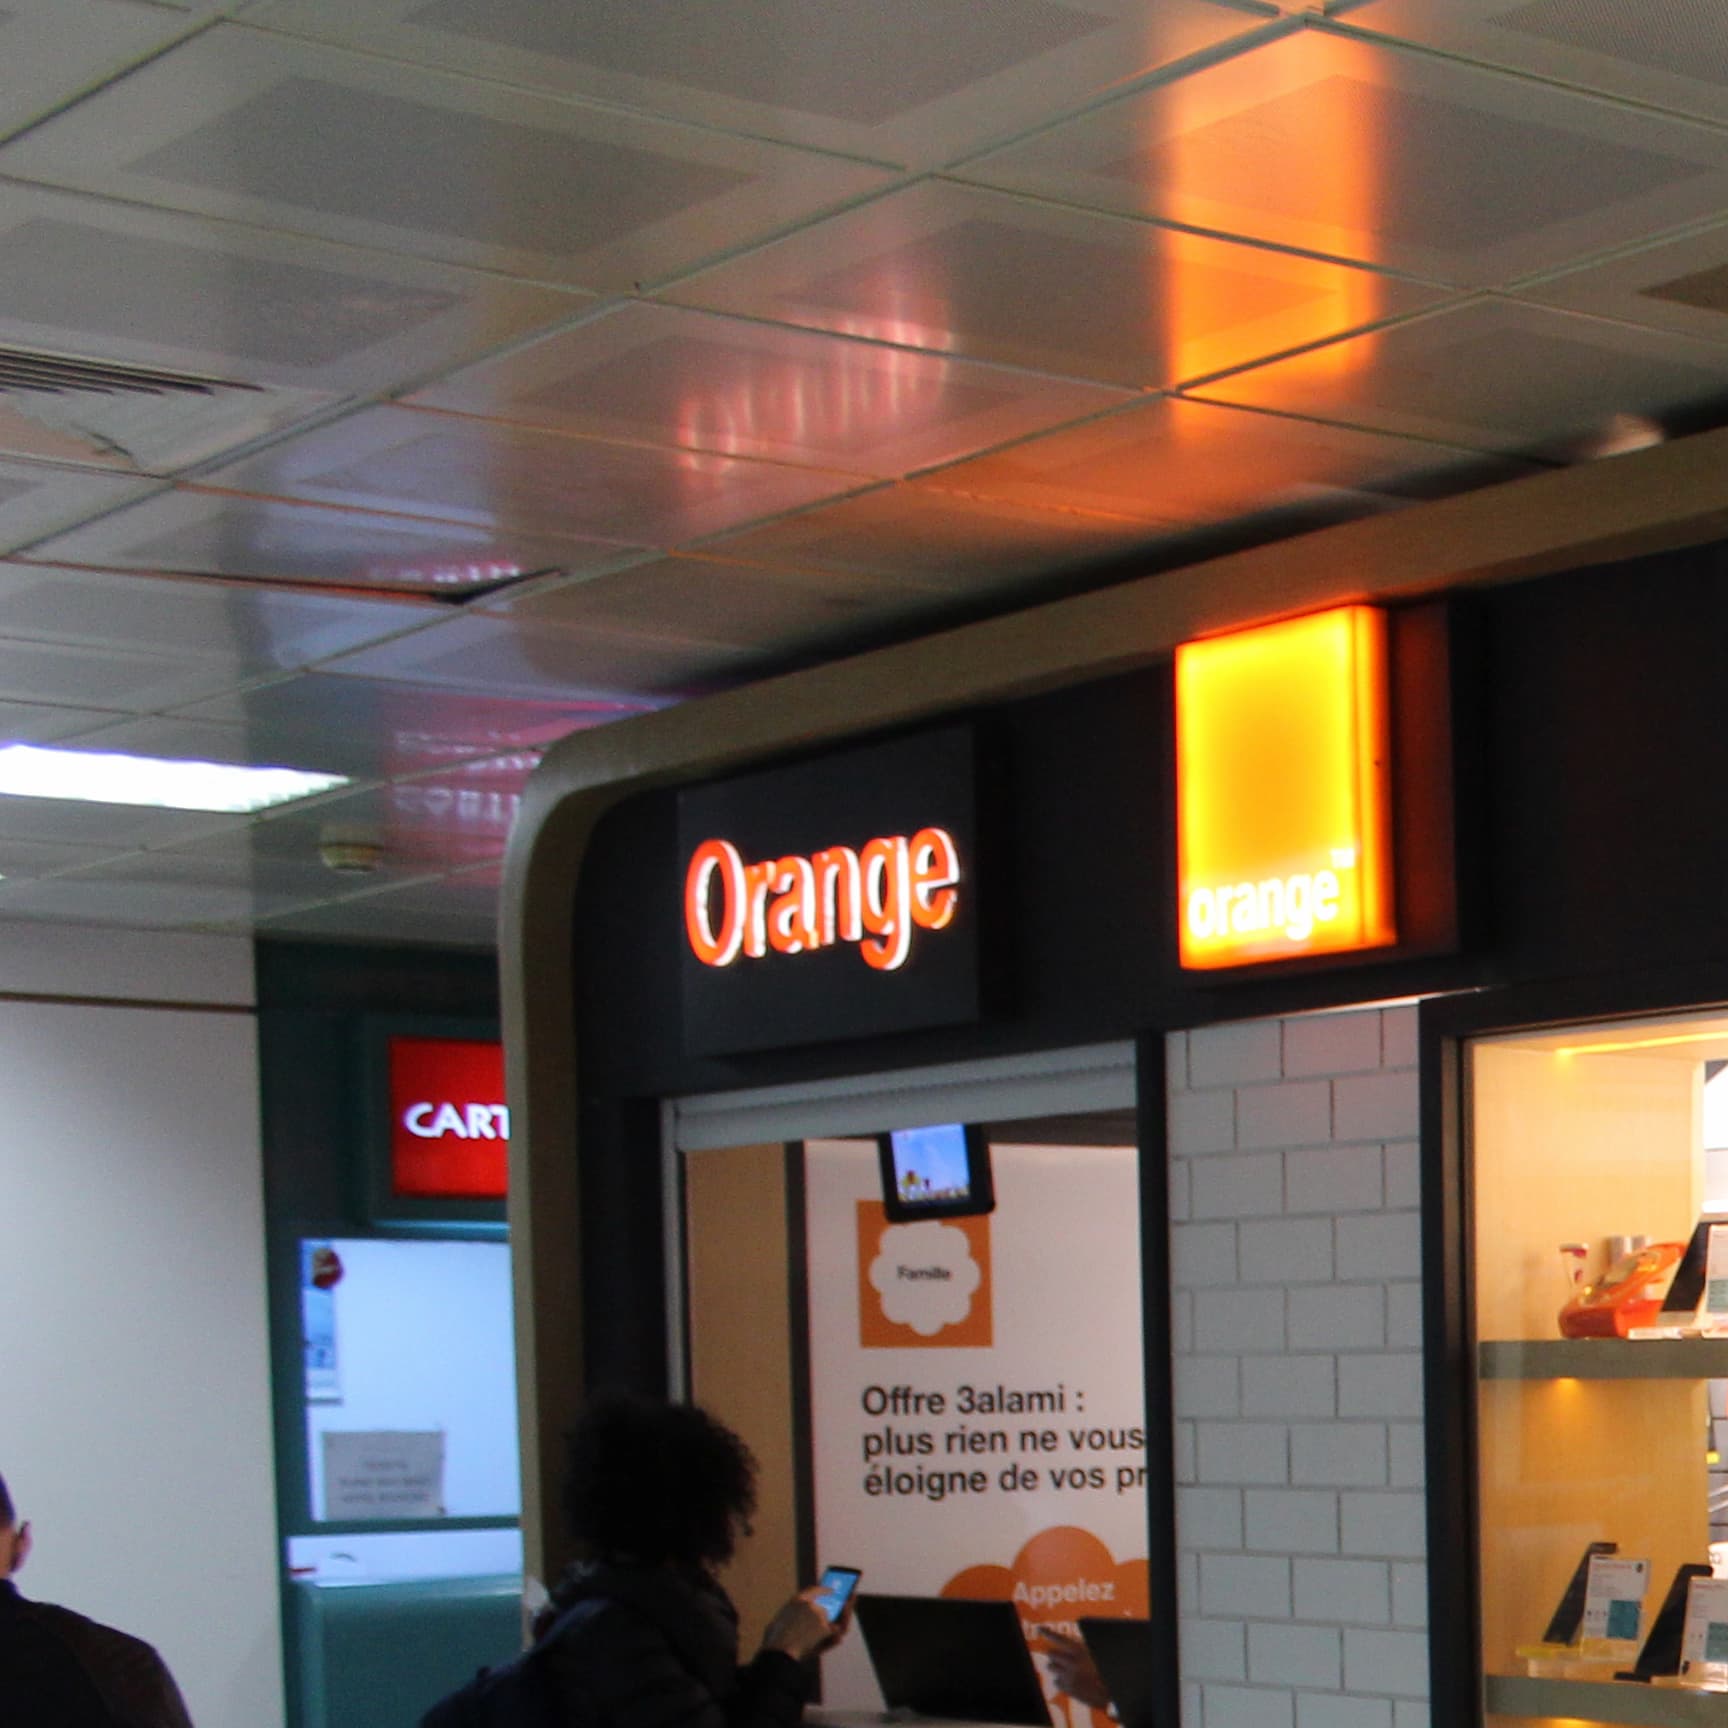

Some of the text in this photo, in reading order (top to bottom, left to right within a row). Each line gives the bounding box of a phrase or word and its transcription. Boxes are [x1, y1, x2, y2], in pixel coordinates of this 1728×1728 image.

[684, 826, 960, 972] Orange
[1186, 868, 1340, 941] orange
[897, 1264, 951, 1280] Famille
[862, 1386, 945, 1416] Offre
[957, 1384, 1065, 1415] 3alami
[863, 1426, 1146, 1462] plus rien ne vous
[863, 1464, 987, 1501] éloigne
[998, 1463, 1038, 1491] de
[1050, 1467, 1106, 1490] vos
[1012, 1577, 1116, 1609] Appelez
